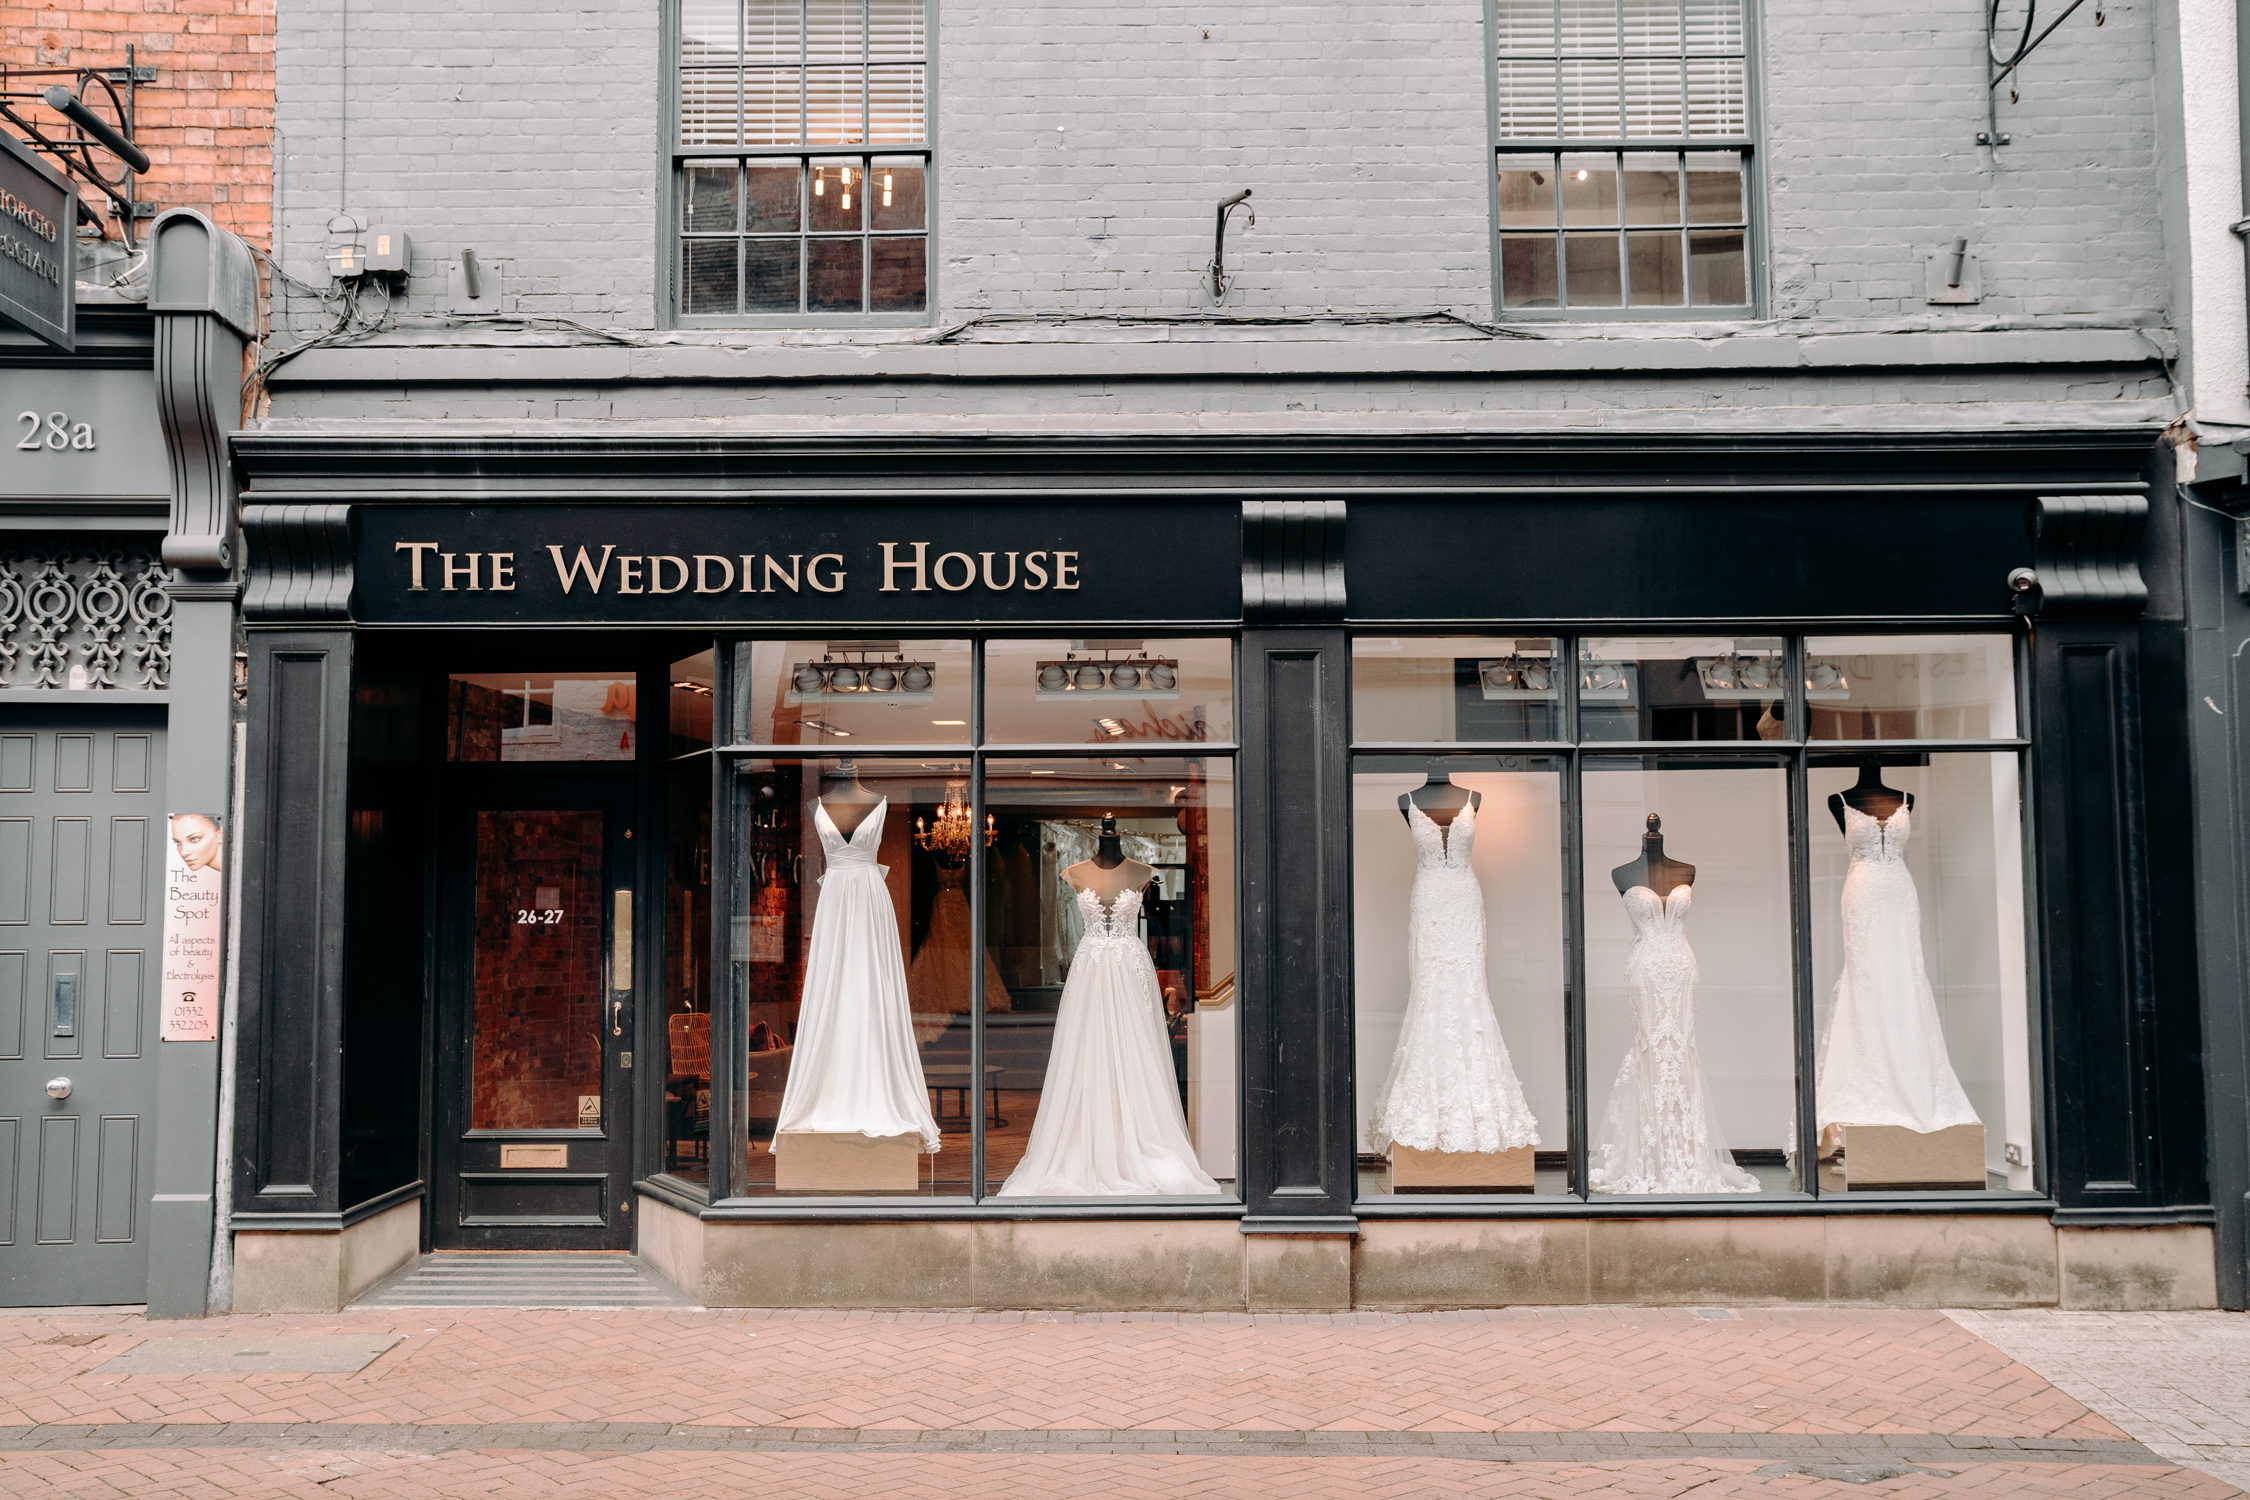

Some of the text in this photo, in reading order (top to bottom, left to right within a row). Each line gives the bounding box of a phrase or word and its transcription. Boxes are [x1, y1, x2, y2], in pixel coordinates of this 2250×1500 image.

[16, 411, 96, 450] 28a
[395, 542, 1080, 594] THE WEDDING HOUSE
[170, 868, 198, 883] The
[170, 886, 219, 907] Beauty
[174, 905, 210, 926] Spot
[517, 909, 565, 924] 26-27
[168, 933, 216, 949] All aspects
[170, 945, 213, 961] of beauty
[186, 960, 195, 969] &
[166, 969, 215, 985] Electrolysis
[174, 1006, 204, 1019] 01332
[168, 1020, 209, 1033] 332203
